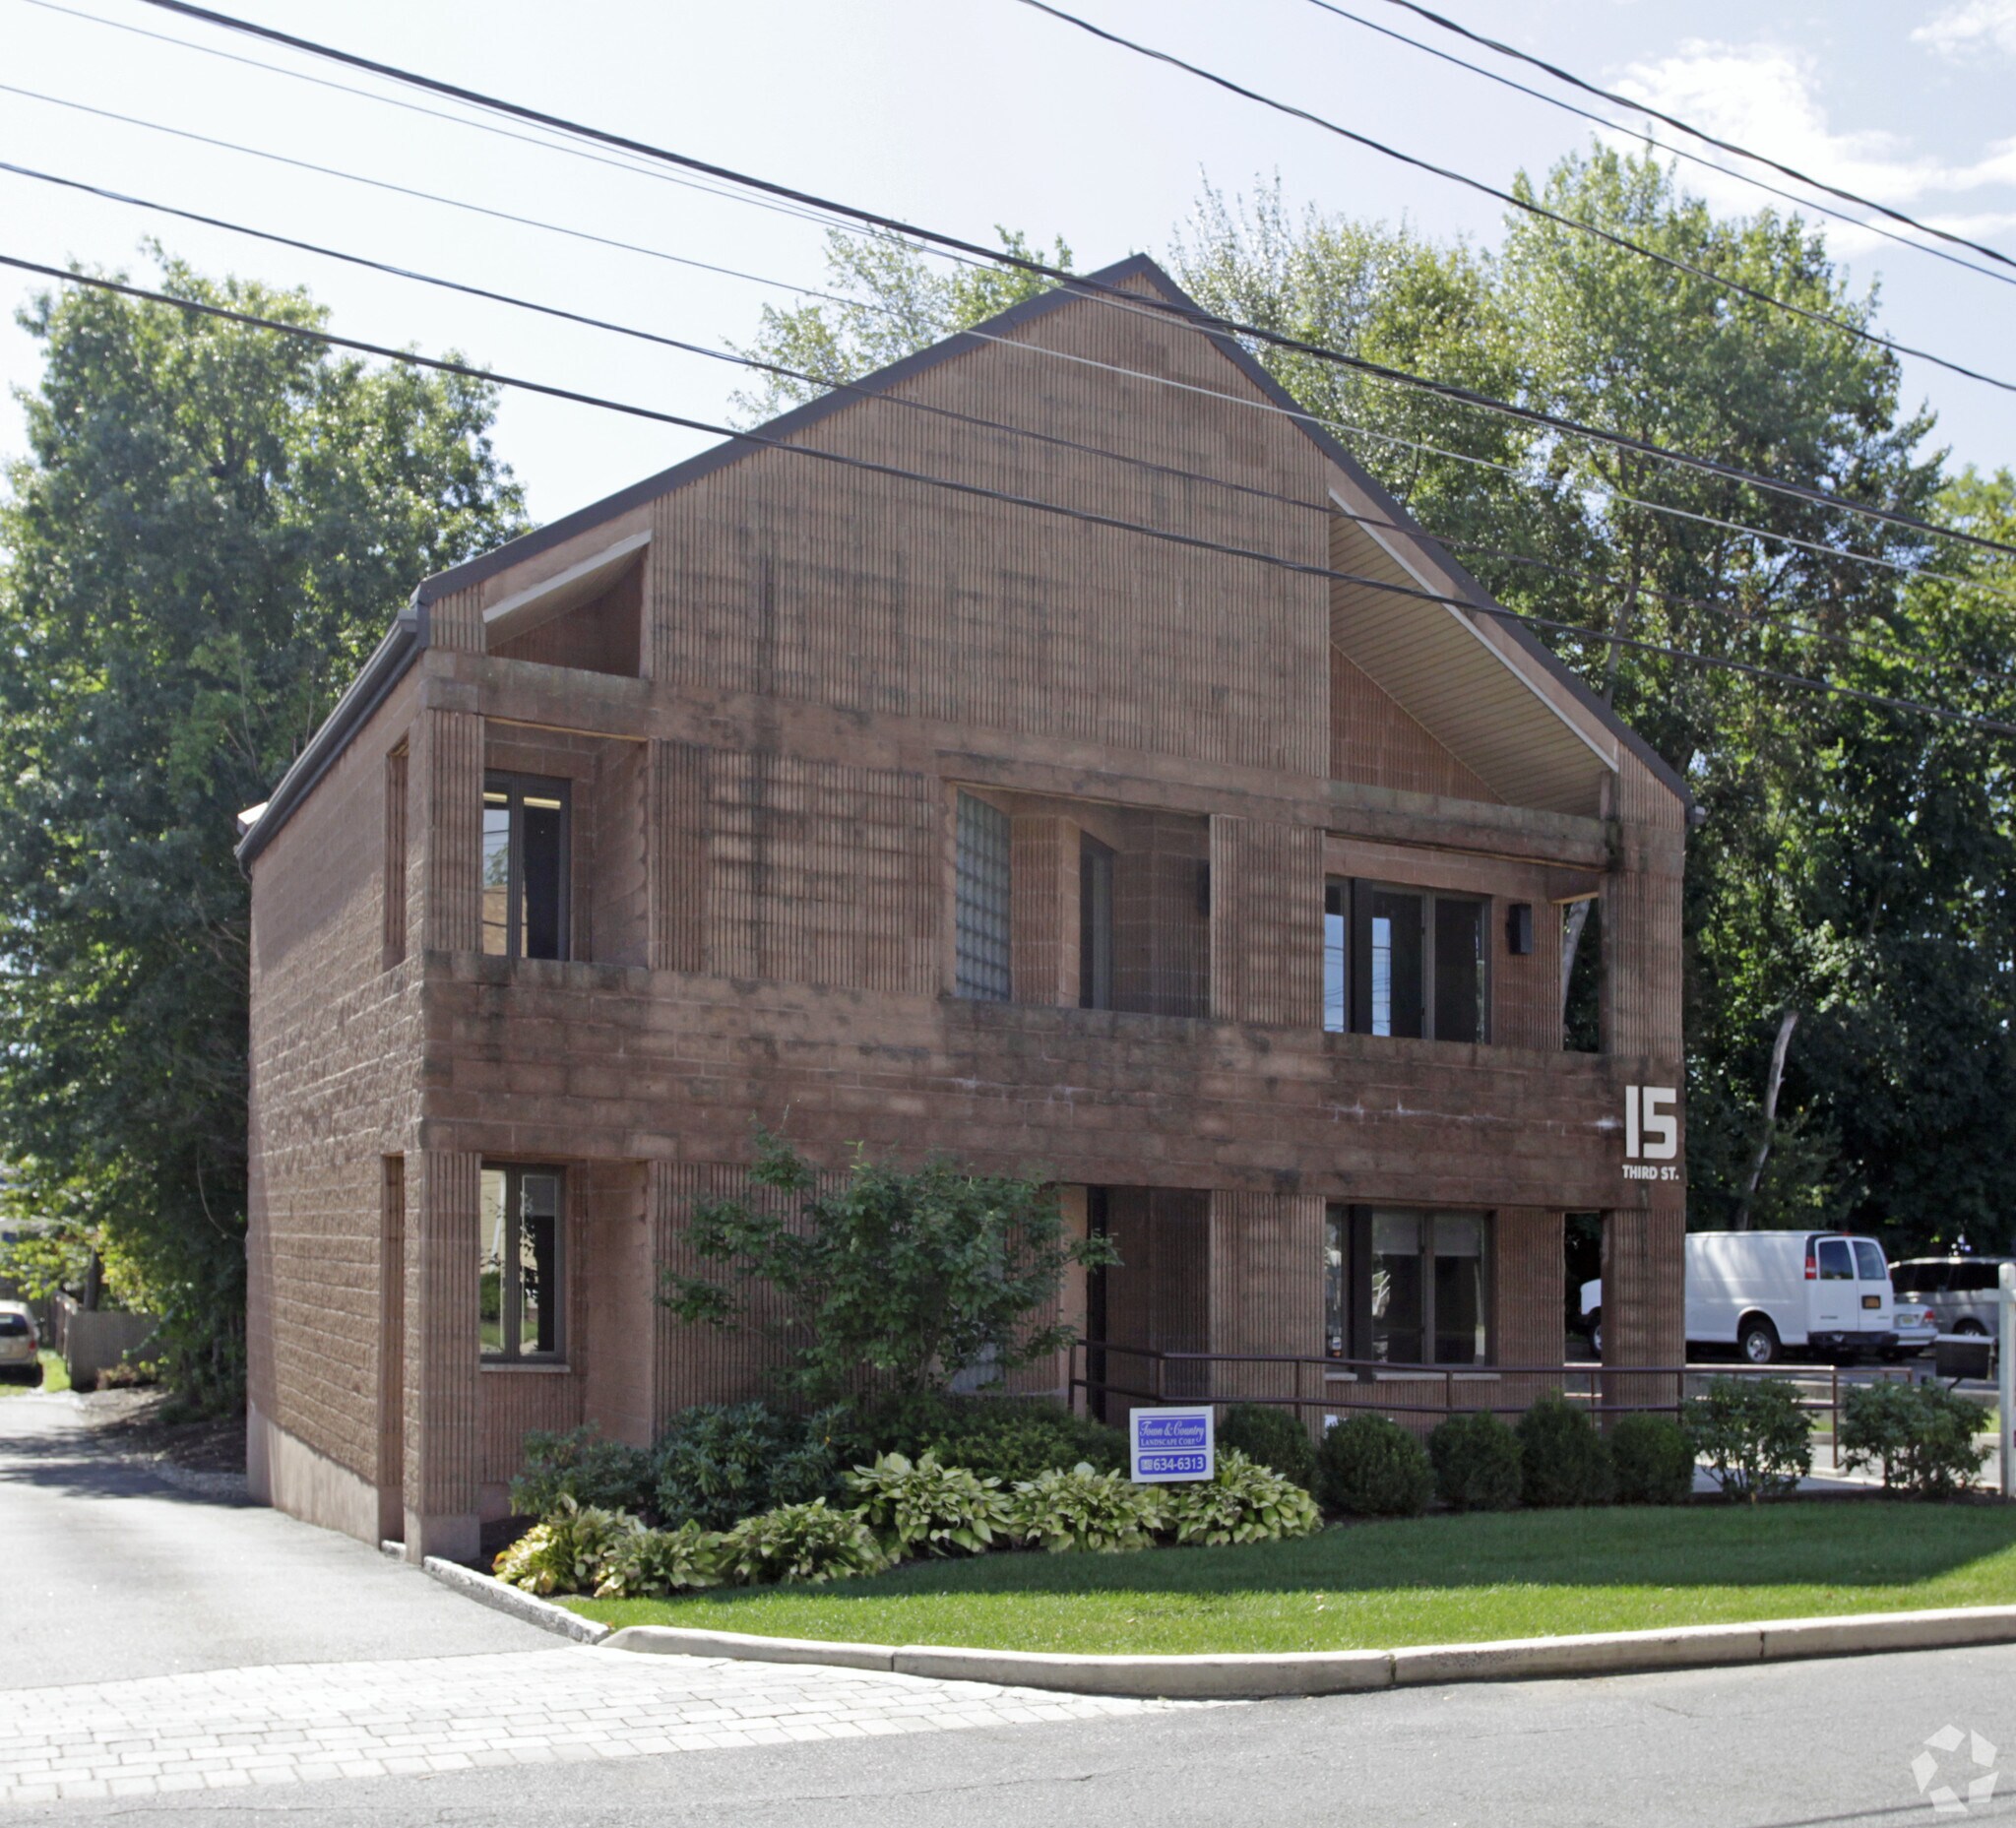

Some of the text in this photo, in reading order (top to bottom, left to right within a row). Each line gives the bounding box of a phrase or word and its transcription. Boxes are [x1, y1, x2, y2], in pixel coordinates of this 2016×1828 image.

[1625, 1085, 1677, 1160] 15
[1622, 1165, 1679, 1180] THIRD ST.
[1139, 1420, 1204, 1442] Town & Country
[1140, 1438, 1177, 1447] LANDSCAPE
[1153, 1457, 1204, 1472] 634-6313
